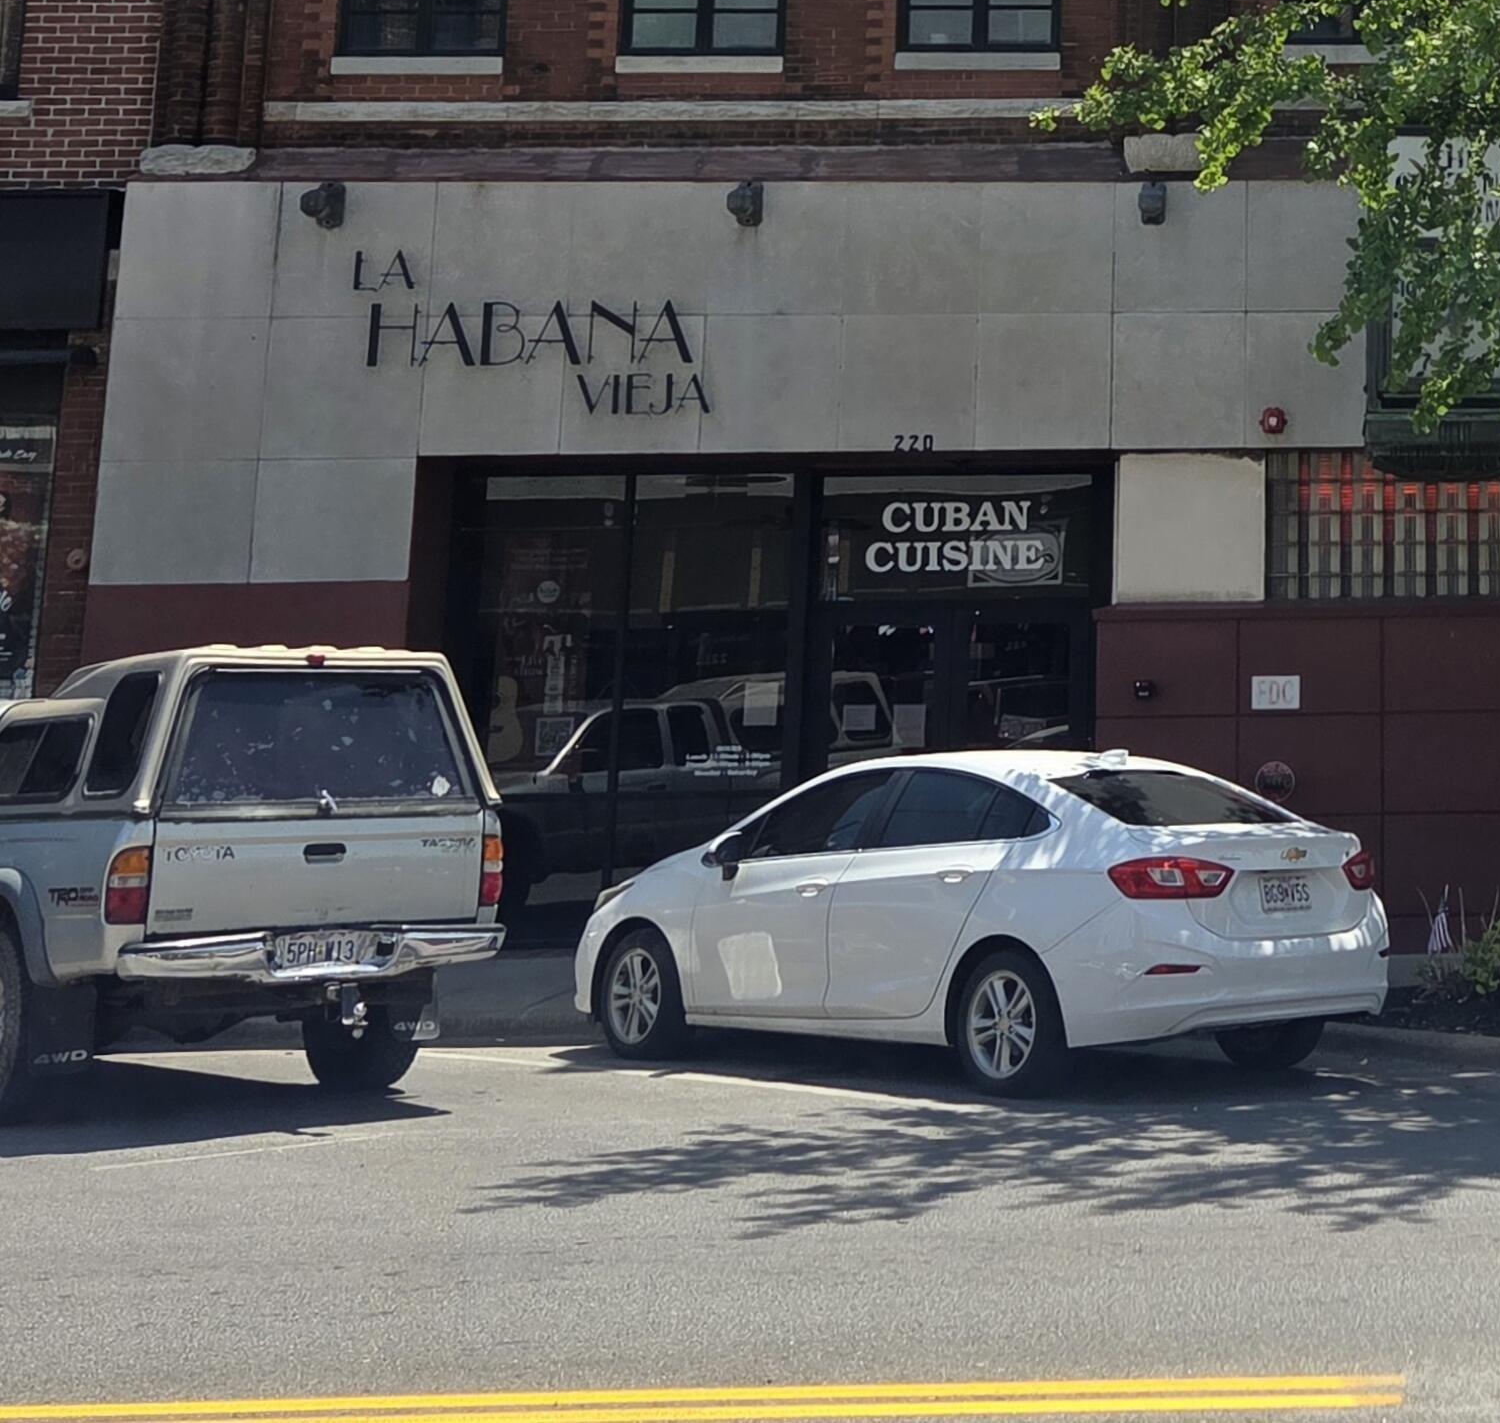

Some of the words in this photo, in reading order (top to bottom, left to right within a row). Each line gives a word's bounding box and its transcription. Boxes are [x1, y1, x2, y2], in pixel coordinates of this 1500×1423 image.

[353, 249, 415, 292] LA
[366, 299, 694, 367] HABANA
[576, 373, 711, 415] VIEJA
[894, 434, 934, 452] 220
[882, 500, 1032, 533] CUBAN
[864, 539, 1045, 573] CUISINE
